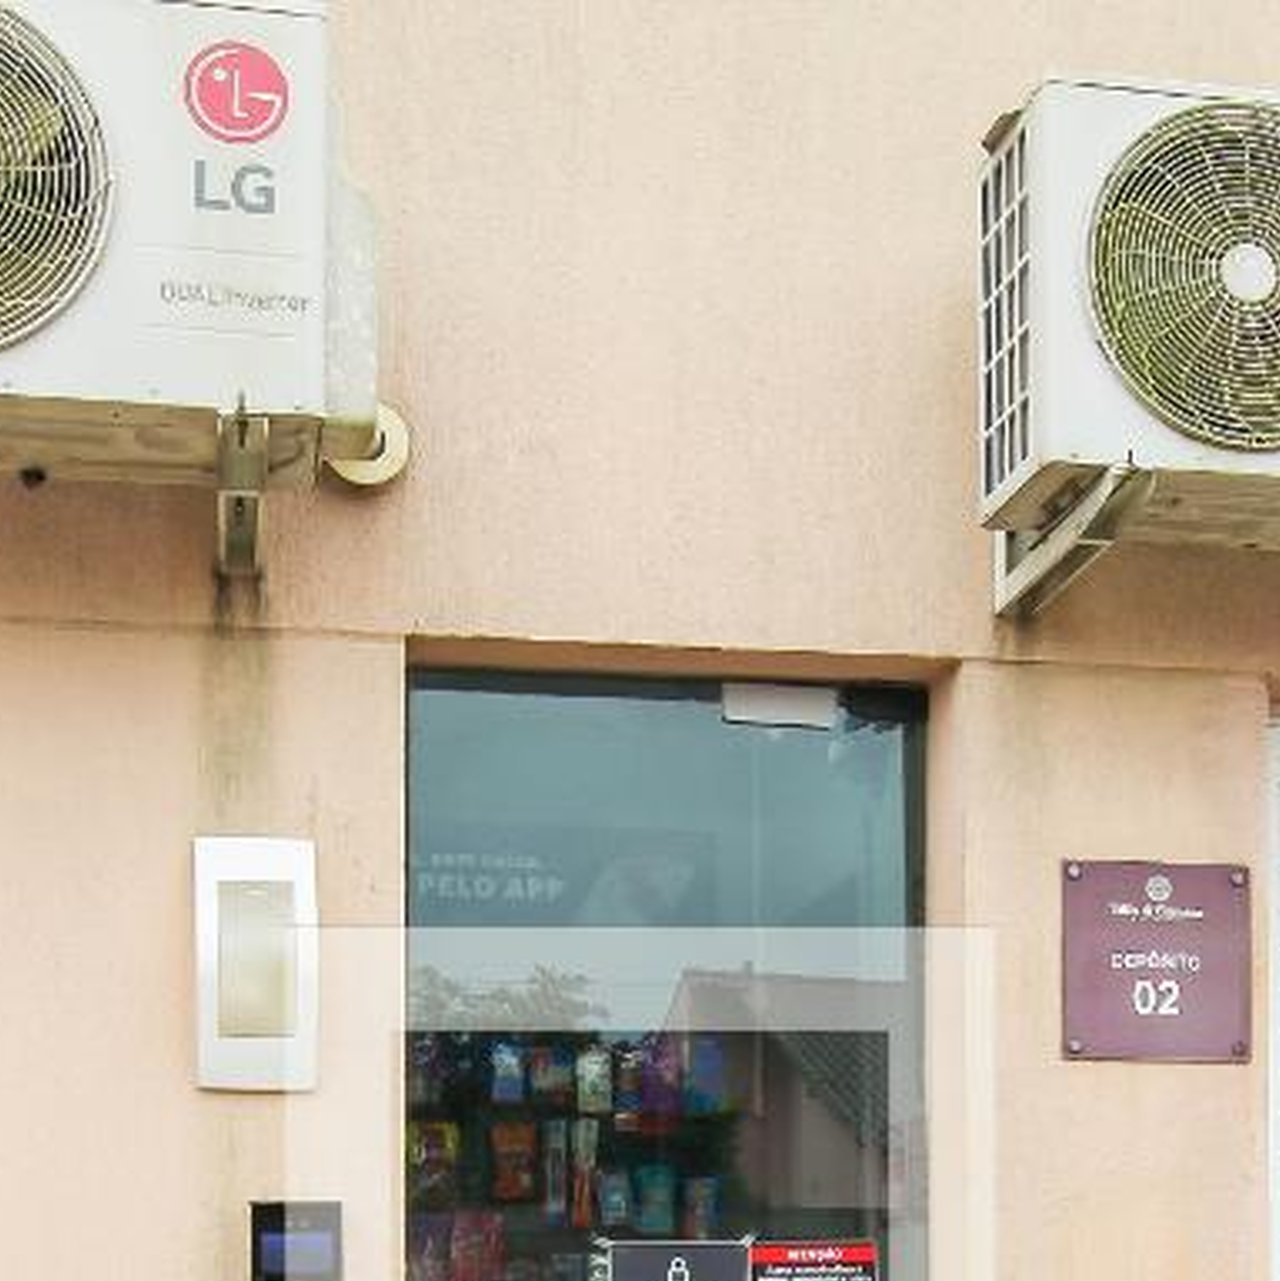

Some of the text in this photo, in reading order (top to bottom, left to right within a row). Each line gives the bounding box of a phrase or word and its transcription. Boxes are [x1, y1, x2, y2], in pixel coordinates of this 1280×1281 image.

[194, 159, 276, 214] LG
[418, 873, 565, 903] PELO APP
[1134, 979, 1181, 1016] 02
